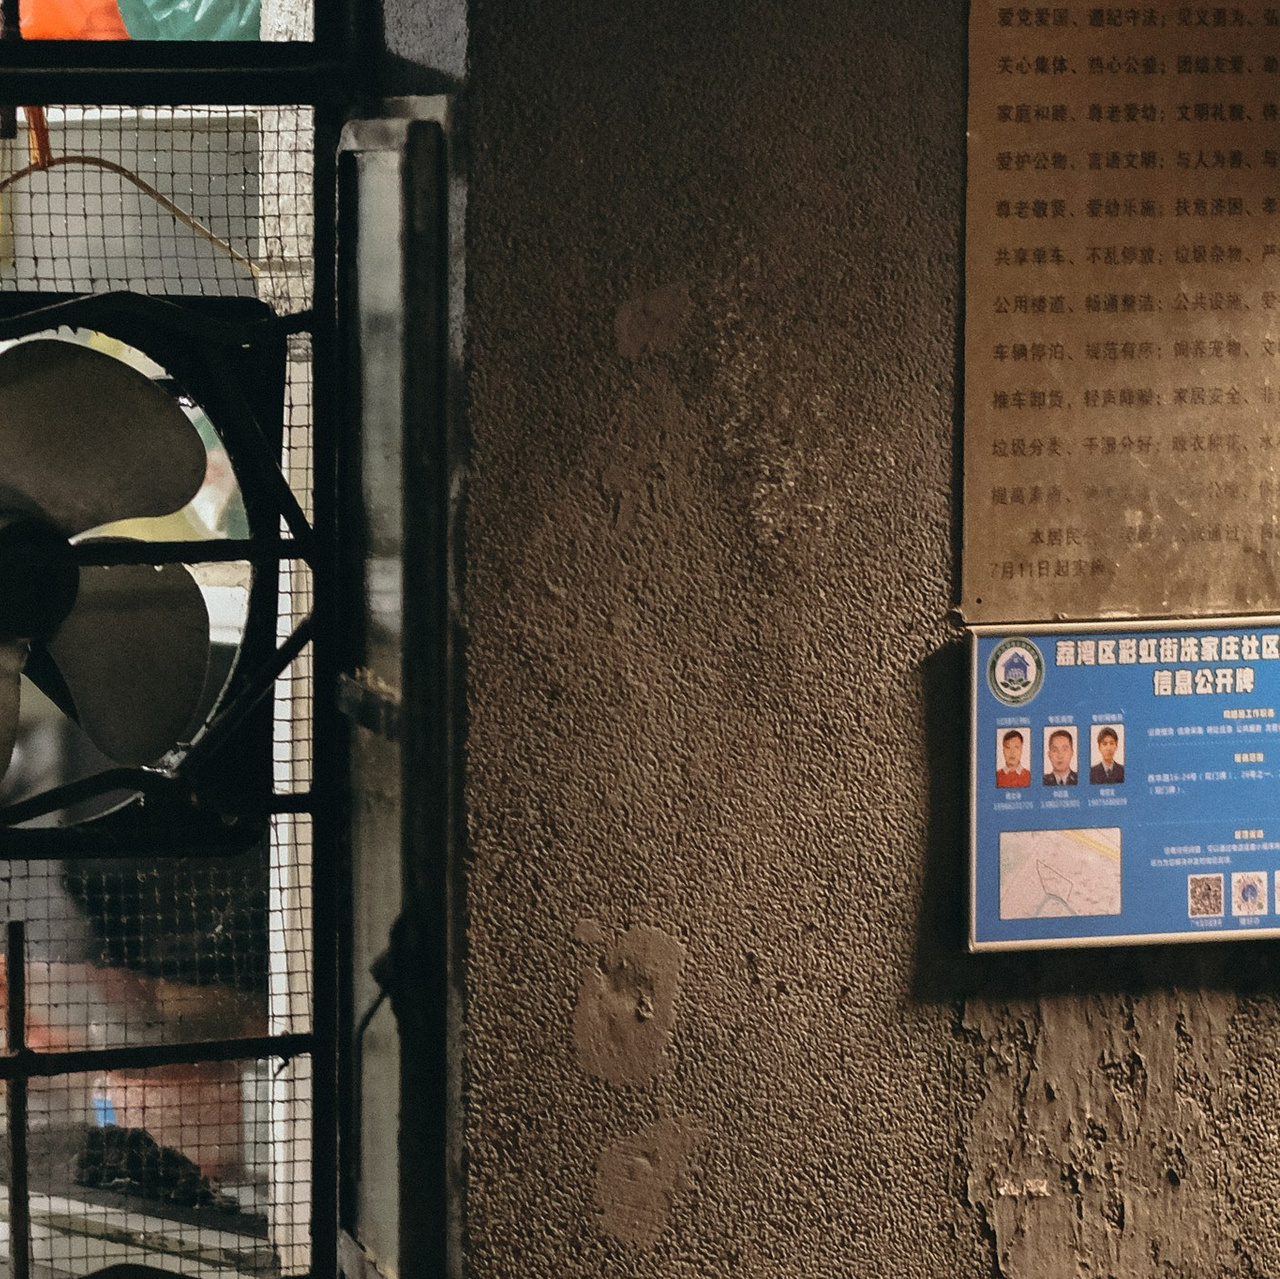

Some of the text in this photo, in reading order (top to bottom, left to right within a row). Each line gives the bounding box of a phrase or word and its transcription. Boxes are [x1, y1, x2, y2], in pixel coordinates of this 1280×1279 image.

[1152, 667, 1256, 697] 信息公开牌
